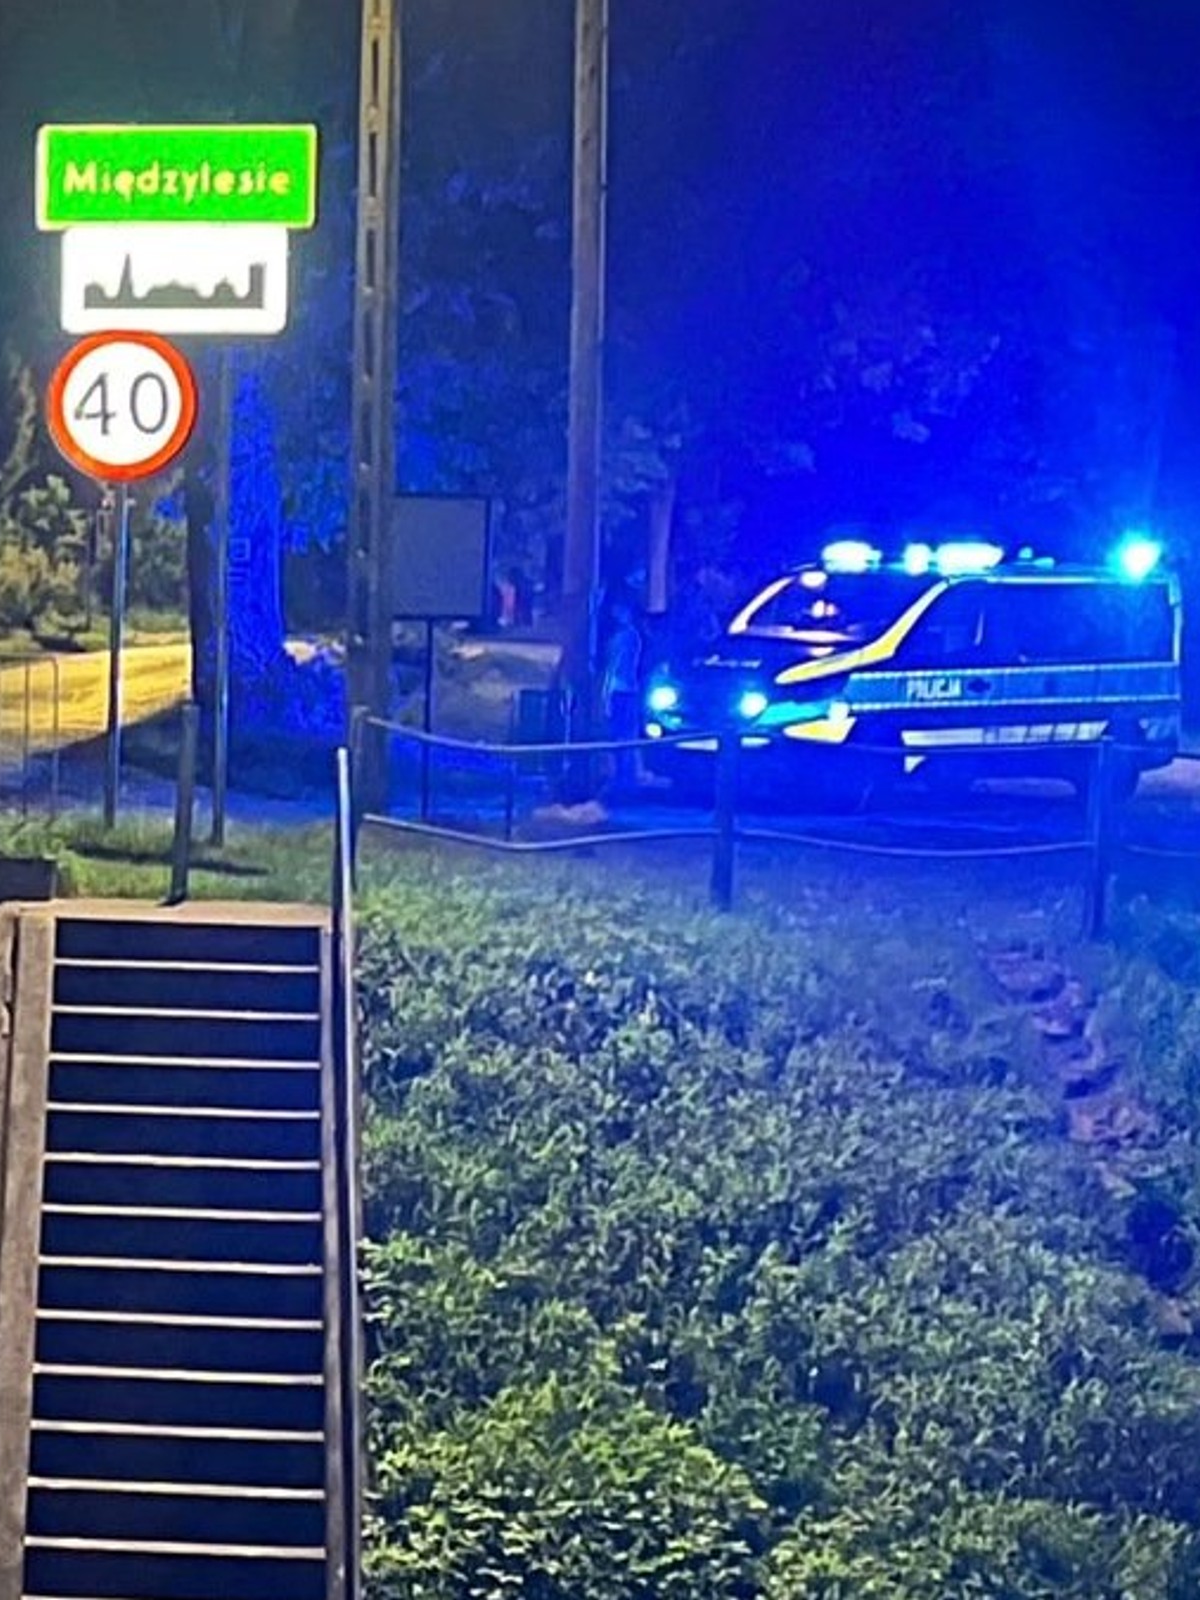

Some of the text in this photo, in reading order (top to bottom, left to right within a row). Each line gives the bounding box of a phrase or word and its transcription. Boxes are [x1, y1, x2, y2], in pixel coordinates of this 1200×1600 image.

[63, 160, 292, 203] Międzylesie
[73, 371, 169, 435] 40
[906, 678, 962, 699] POLICJA
